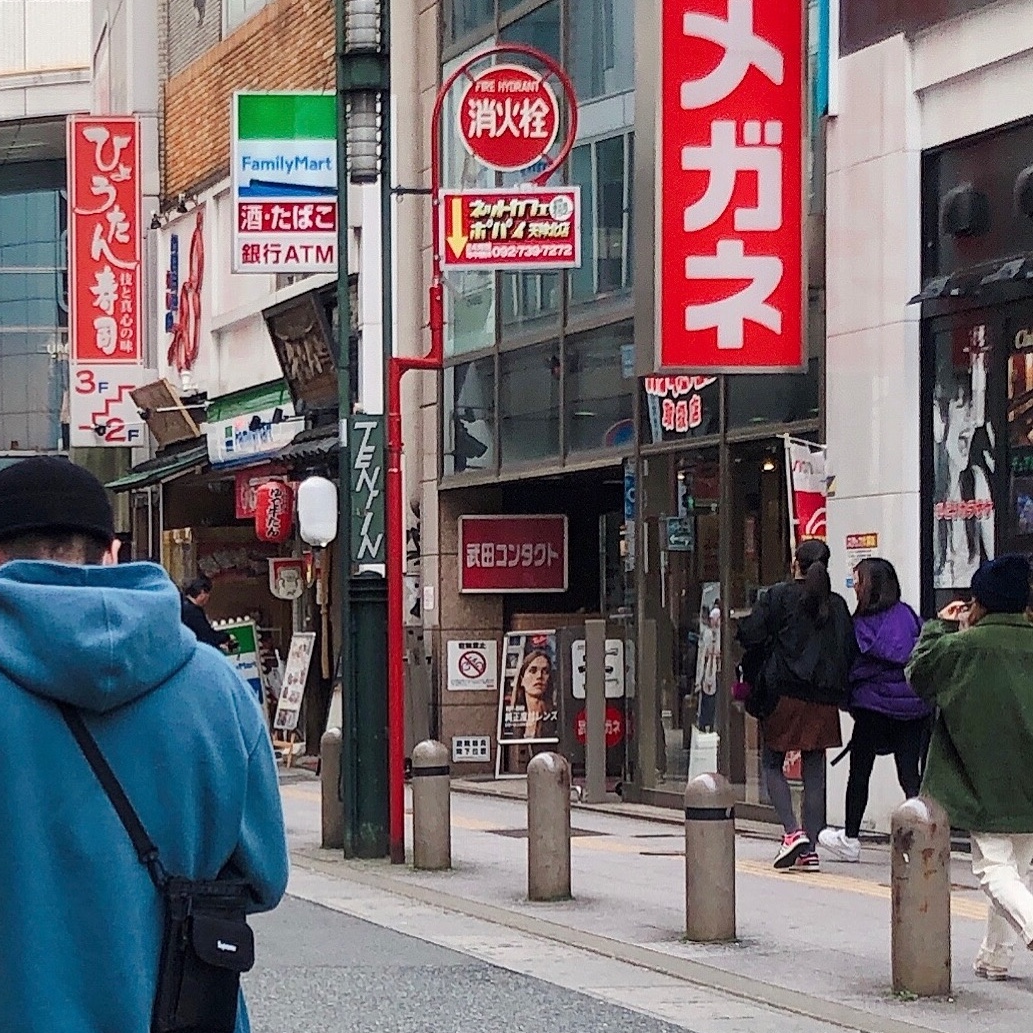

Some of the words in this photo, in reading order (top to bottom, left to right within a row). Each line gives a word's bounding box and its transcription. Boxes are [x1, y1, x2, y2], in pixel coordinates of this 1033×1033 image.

[475, 80, 496, 92] FIRE
[498, 80, 540, 92] HYDRANT
[468, 97, 550, 138] 消火栓
[242, 156, 332, 175] FamilyMart
[680, 0, 784, 349] メガネ
[241, 204, 334, 231] 酒・たばこ
[469, 218, 527, 240] ポパイ
[242, 243, 334, 265] 銀行ATM
[75, 369, 109, 394] 3F
[105, 418, 139, 442] 2F
[354, 421, 383, 560] TENJIN
[466, 542, 559, 568] 武田コンタクト
